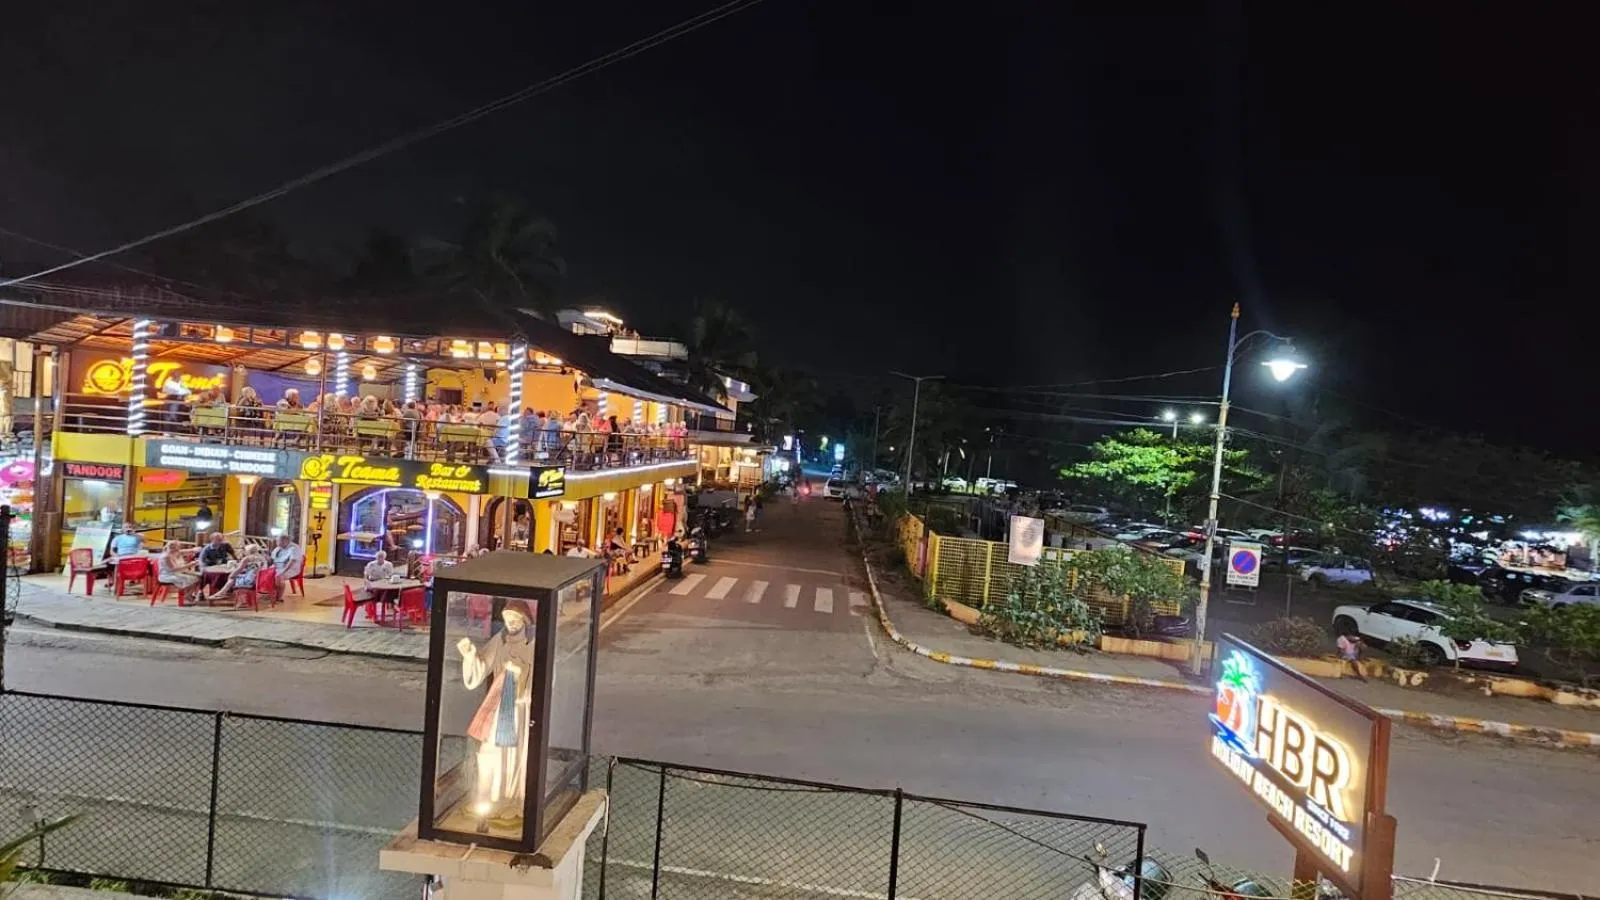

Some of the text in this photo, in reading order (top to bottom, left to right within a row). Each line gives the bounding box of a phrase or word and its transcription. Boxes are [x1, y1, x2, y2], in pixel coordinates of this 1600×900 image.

[160, 444, 188, 455] GOAN
[194, 446, 229, 458] INDIAN
[233, 449, 277, 462] CHINESE
[66, 464, 121, 479] TANDOOR
[160, 456, 223, 469] CONTINENTAL
[431, 462, 455, 477] Bar
[415, 474, 481, 492] Restaurant
[1256, 697, 1341, 820] HBR
[1253, 769, 1294, 824] BEACH
[1294, 804, 1354, 873] RESORT
